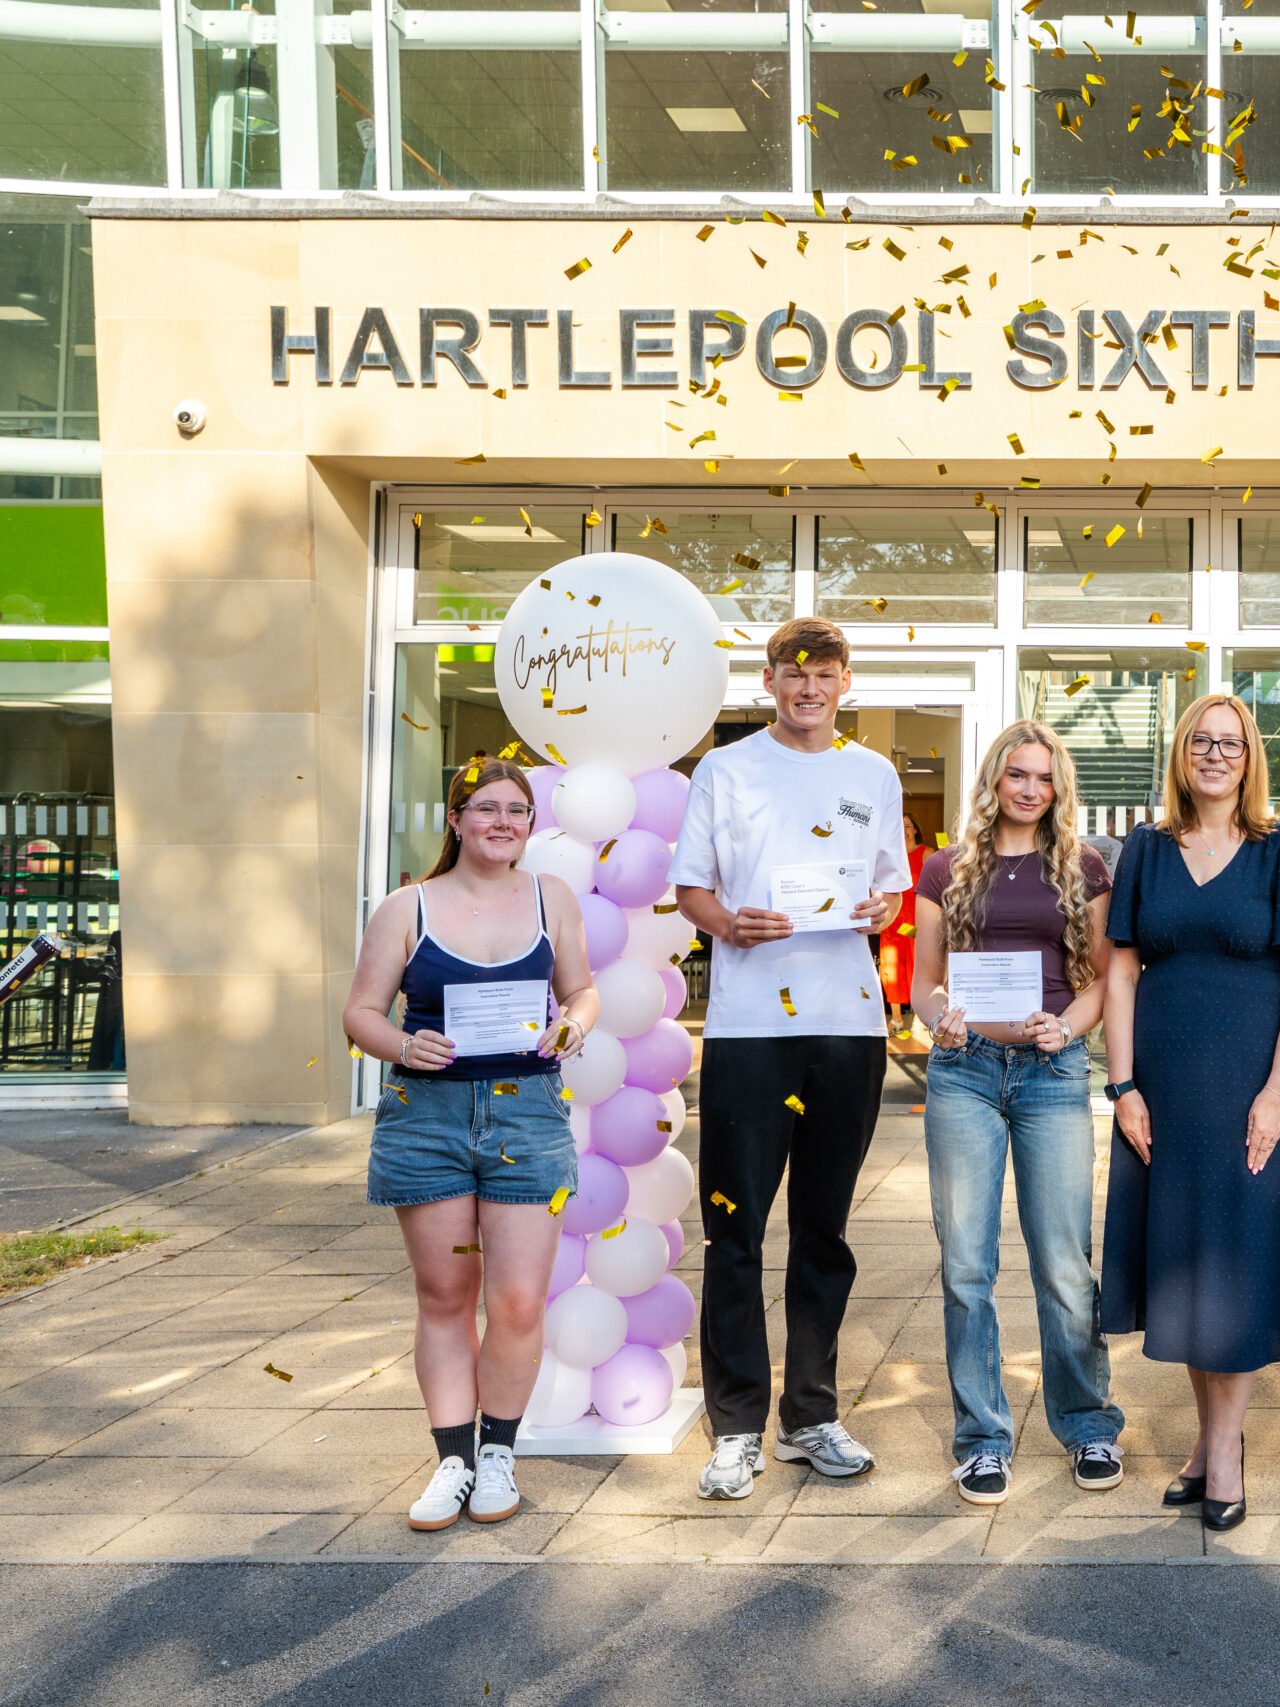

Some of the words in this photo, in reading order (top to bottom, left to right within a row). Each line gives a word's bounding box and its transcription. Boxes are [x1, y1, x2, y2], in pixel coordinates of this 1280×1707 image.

[270, 304, 973, 390] HARTLEPOOL
[514, 619, 676, 695] Congratulations
[0, 956, 25, 982] onfetti
